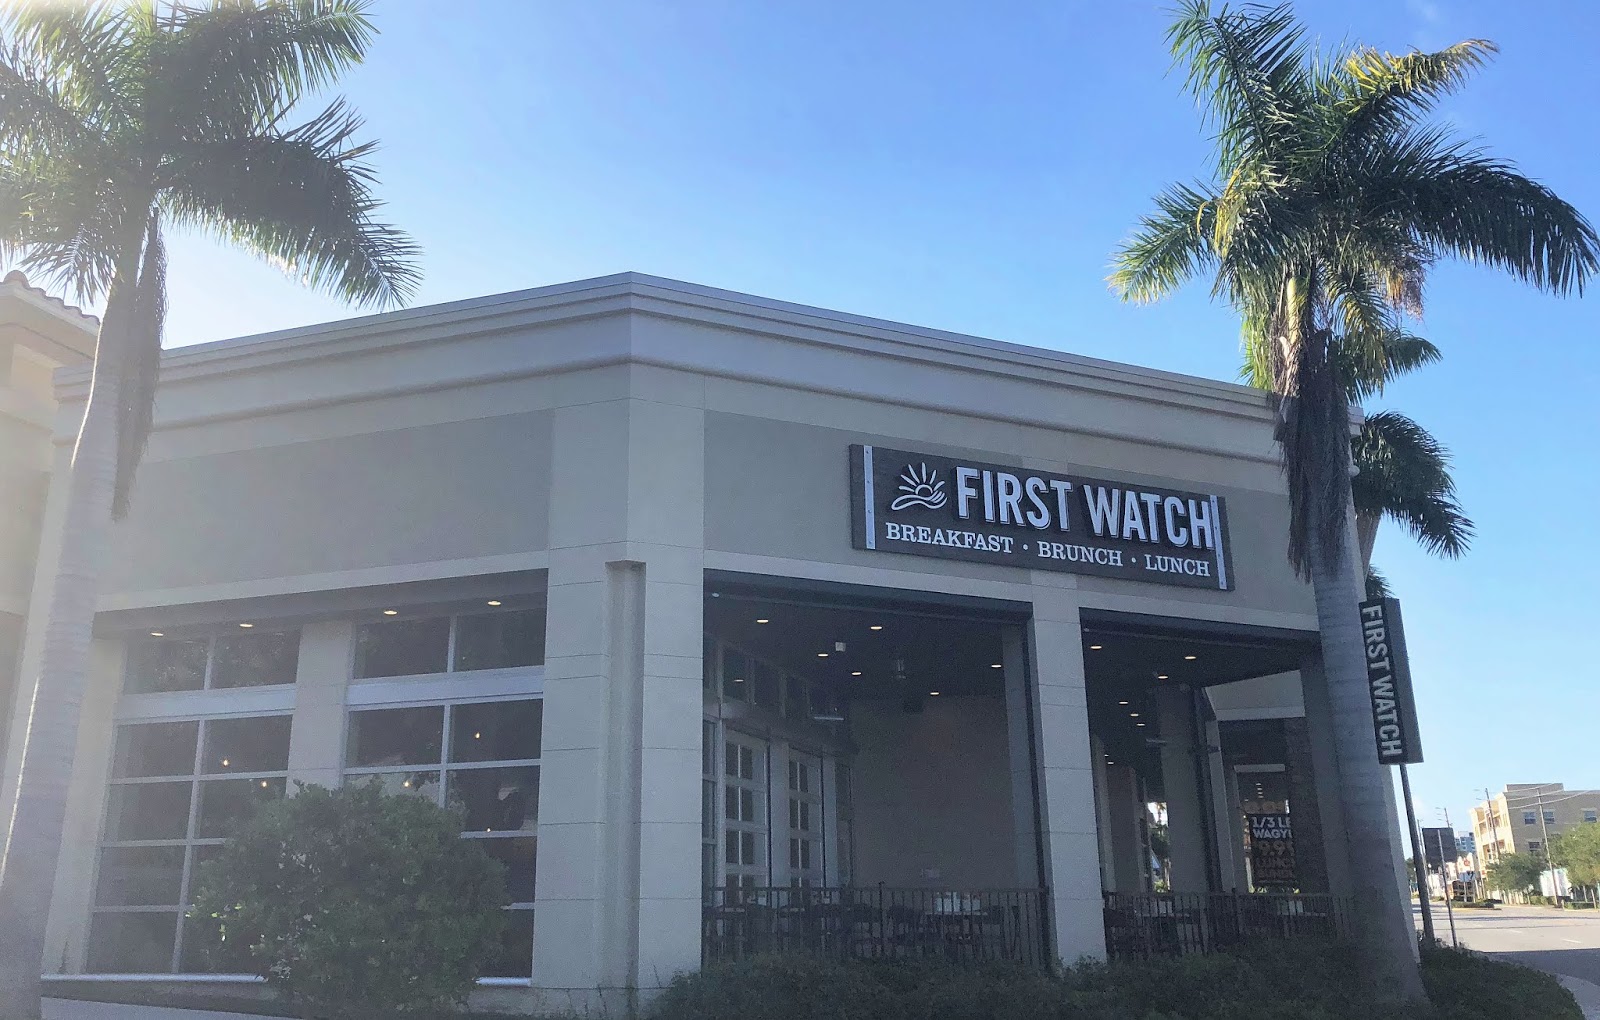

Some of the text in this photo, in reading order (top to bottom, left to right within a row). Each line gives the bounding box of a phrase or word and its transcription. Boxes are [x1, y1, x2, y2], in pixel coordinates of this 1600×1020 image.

[956, 466, 1215, 551] FIRST WATCH
[885, 522, 1211, 577] BREAKFAST BRUNCH LUNCH
[1362, 604, 1403, 756] FIRST WATCH
[1251, 816, 1275, 828] 1/3
